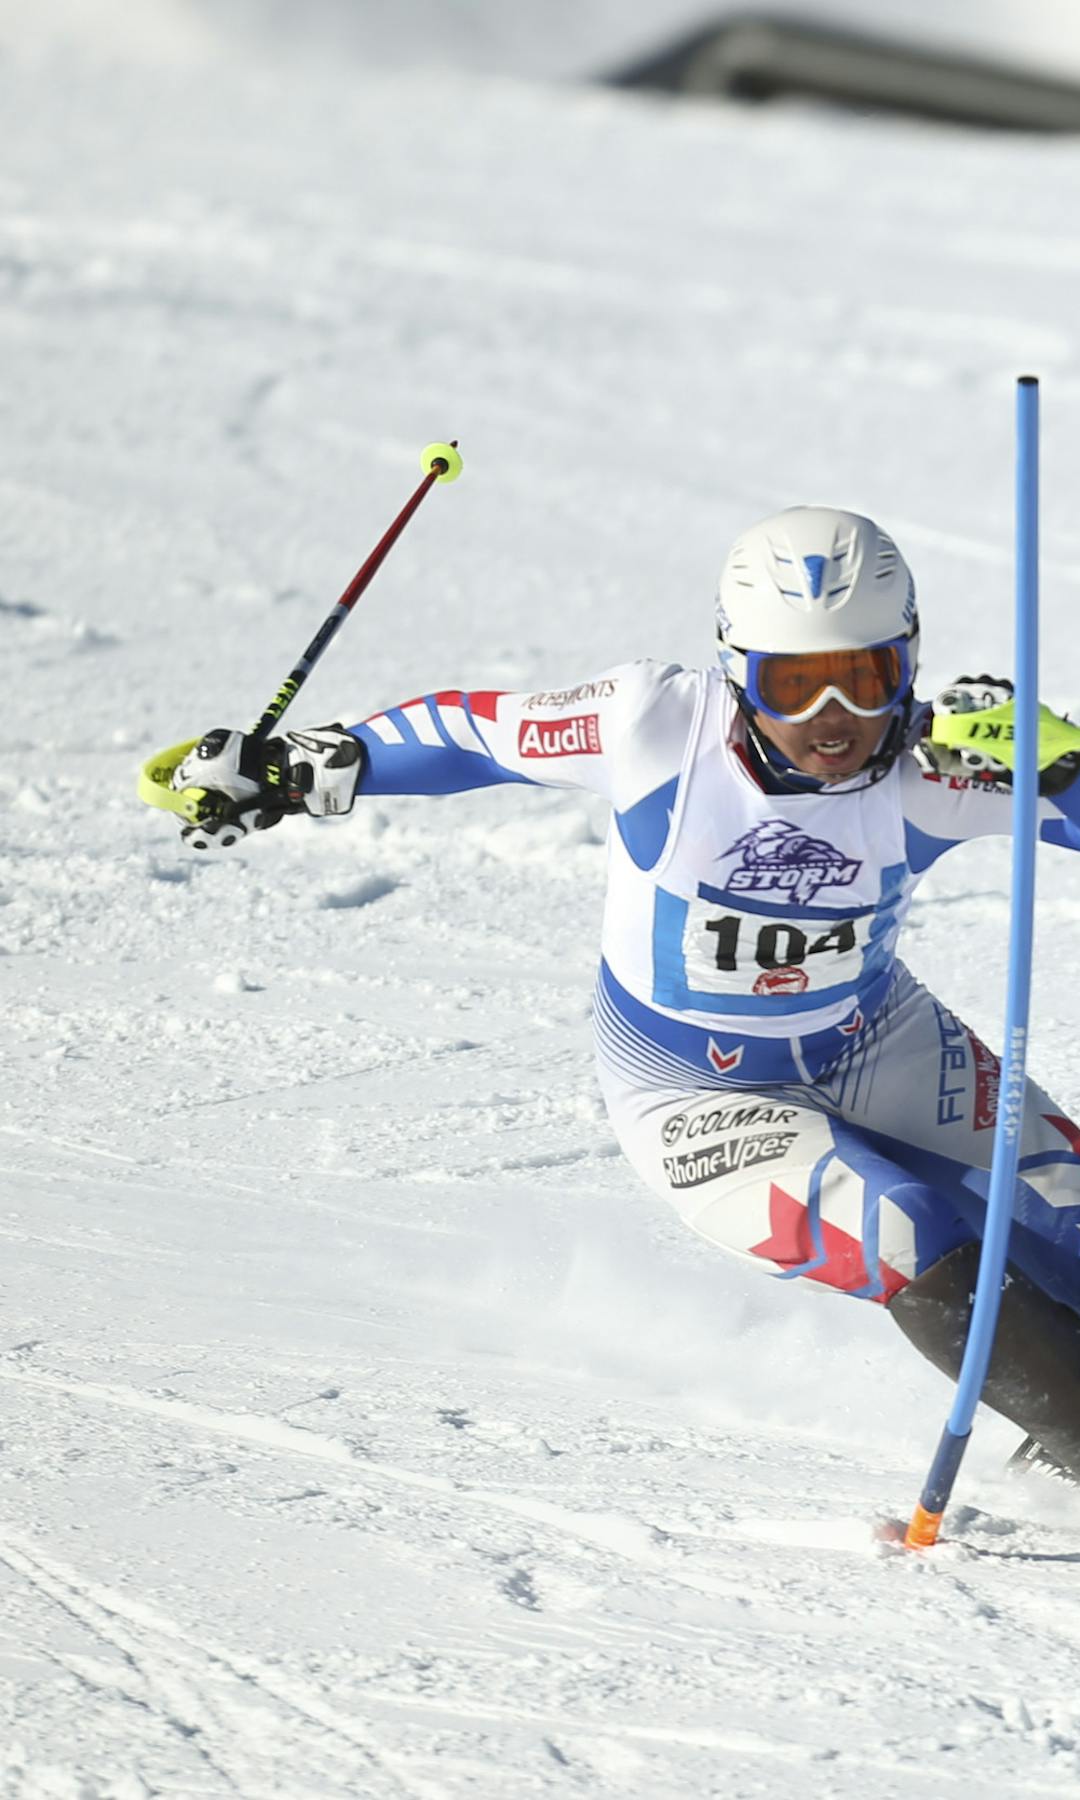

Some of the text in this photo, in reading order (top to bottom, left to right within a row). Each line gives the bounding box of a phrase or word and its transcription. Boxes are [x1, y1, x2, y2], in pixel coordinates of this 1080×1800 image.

[520, 720, 588, 754] Audi
[968, 722, 1015, 741] EKI
[727, 862, 860, 890] STORM
[705, 915, 857, 972] 104
[686, 1106, 799, 1140] COLMAR
